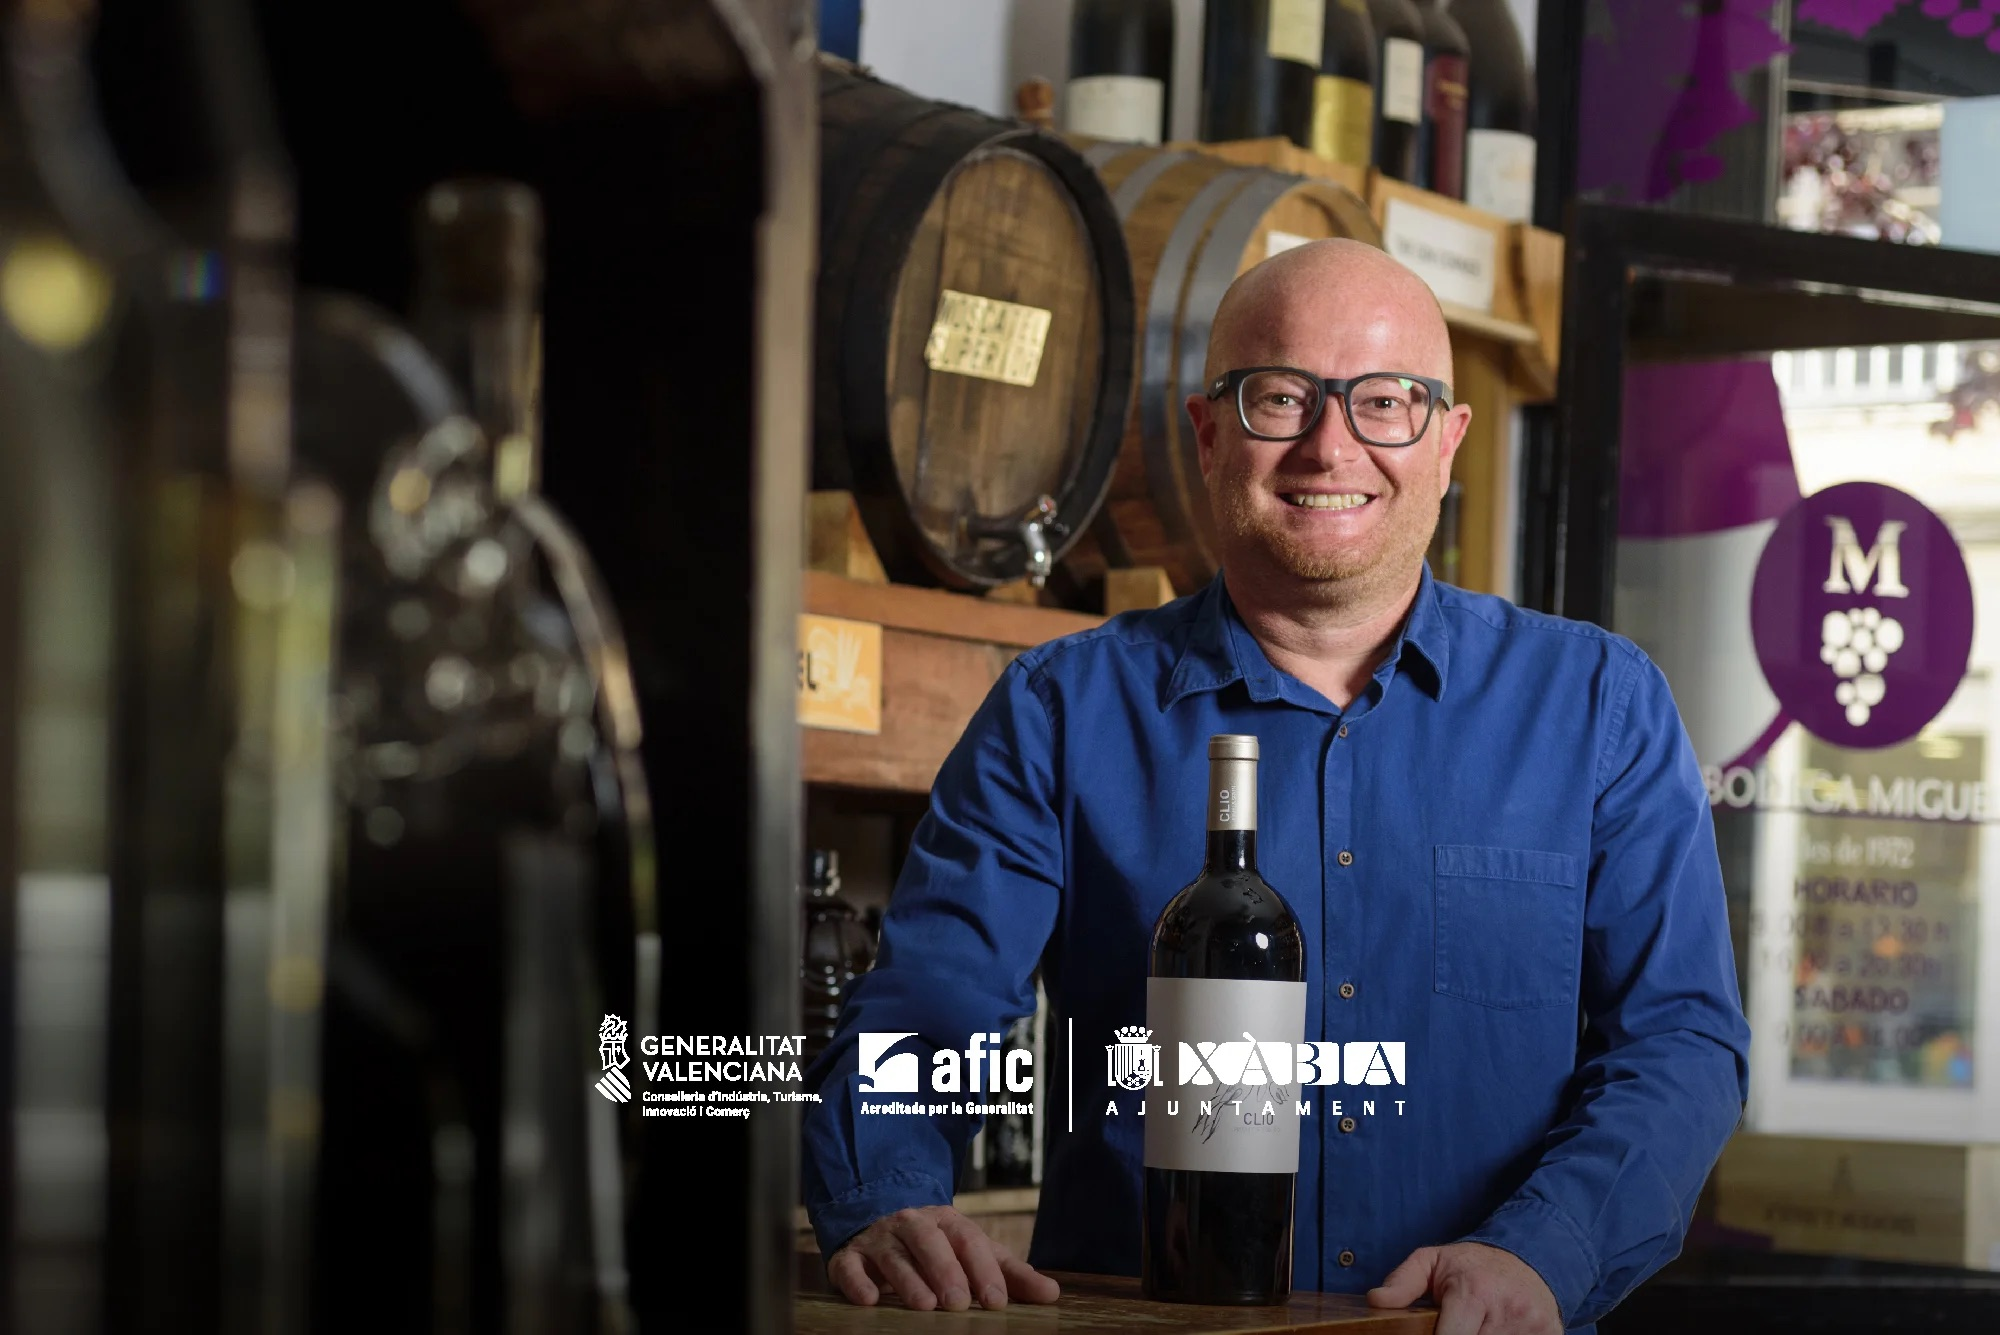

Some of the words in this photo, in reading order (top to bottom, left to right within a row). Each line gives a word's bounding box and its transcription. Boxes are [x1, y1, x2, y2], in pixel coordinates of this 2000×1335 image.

[1822, 514, 1910, 598] M
[1219, 789, 1230, 821] CLIO
[1702, 764, 1858, 814] BOGA
[1794, 876, 1919, 909] HORARIO
[1243, 1112, 1274, 1126] CLIO
